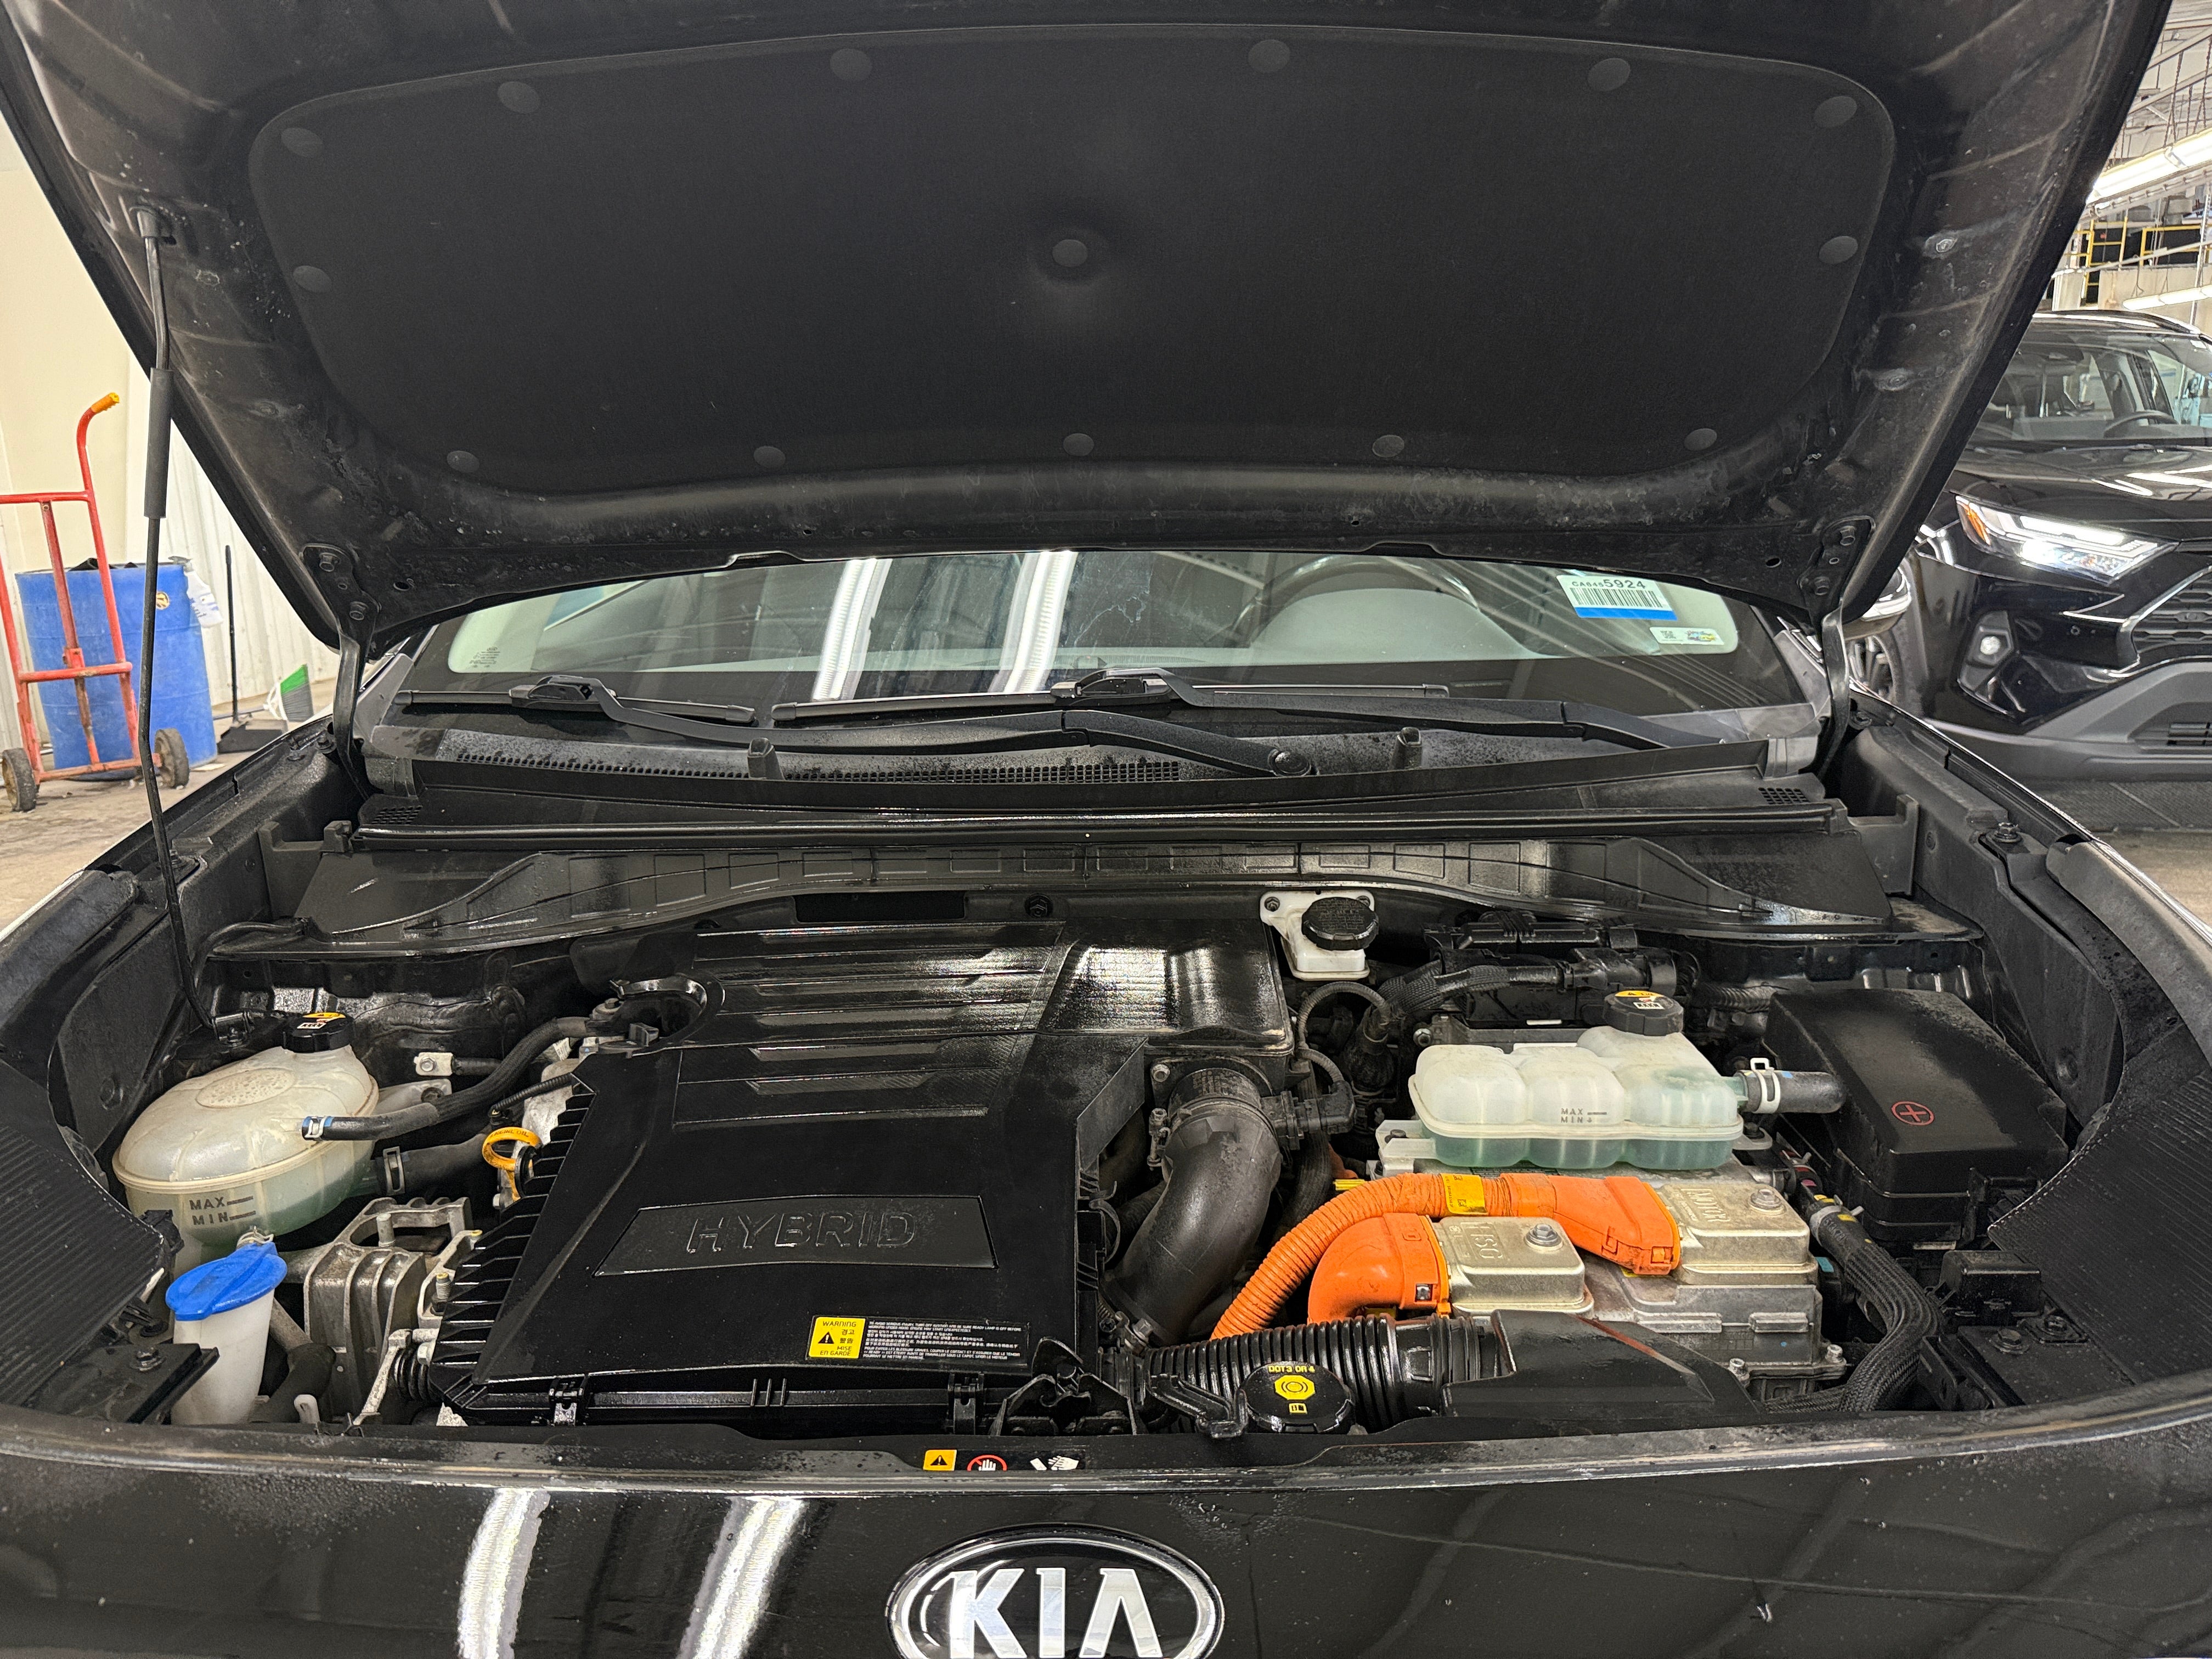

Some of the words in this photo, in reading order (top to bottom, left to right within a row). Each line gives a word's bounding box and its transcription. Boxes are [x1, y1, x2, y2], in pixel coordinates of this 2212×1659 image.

[189, 1197, 225, 1210] MAX
[192, 1212, 228, 1225] MIN
[687, 1212, 917, 1253] HYBRID
[950, 1567, 1163, 1658] KIA
